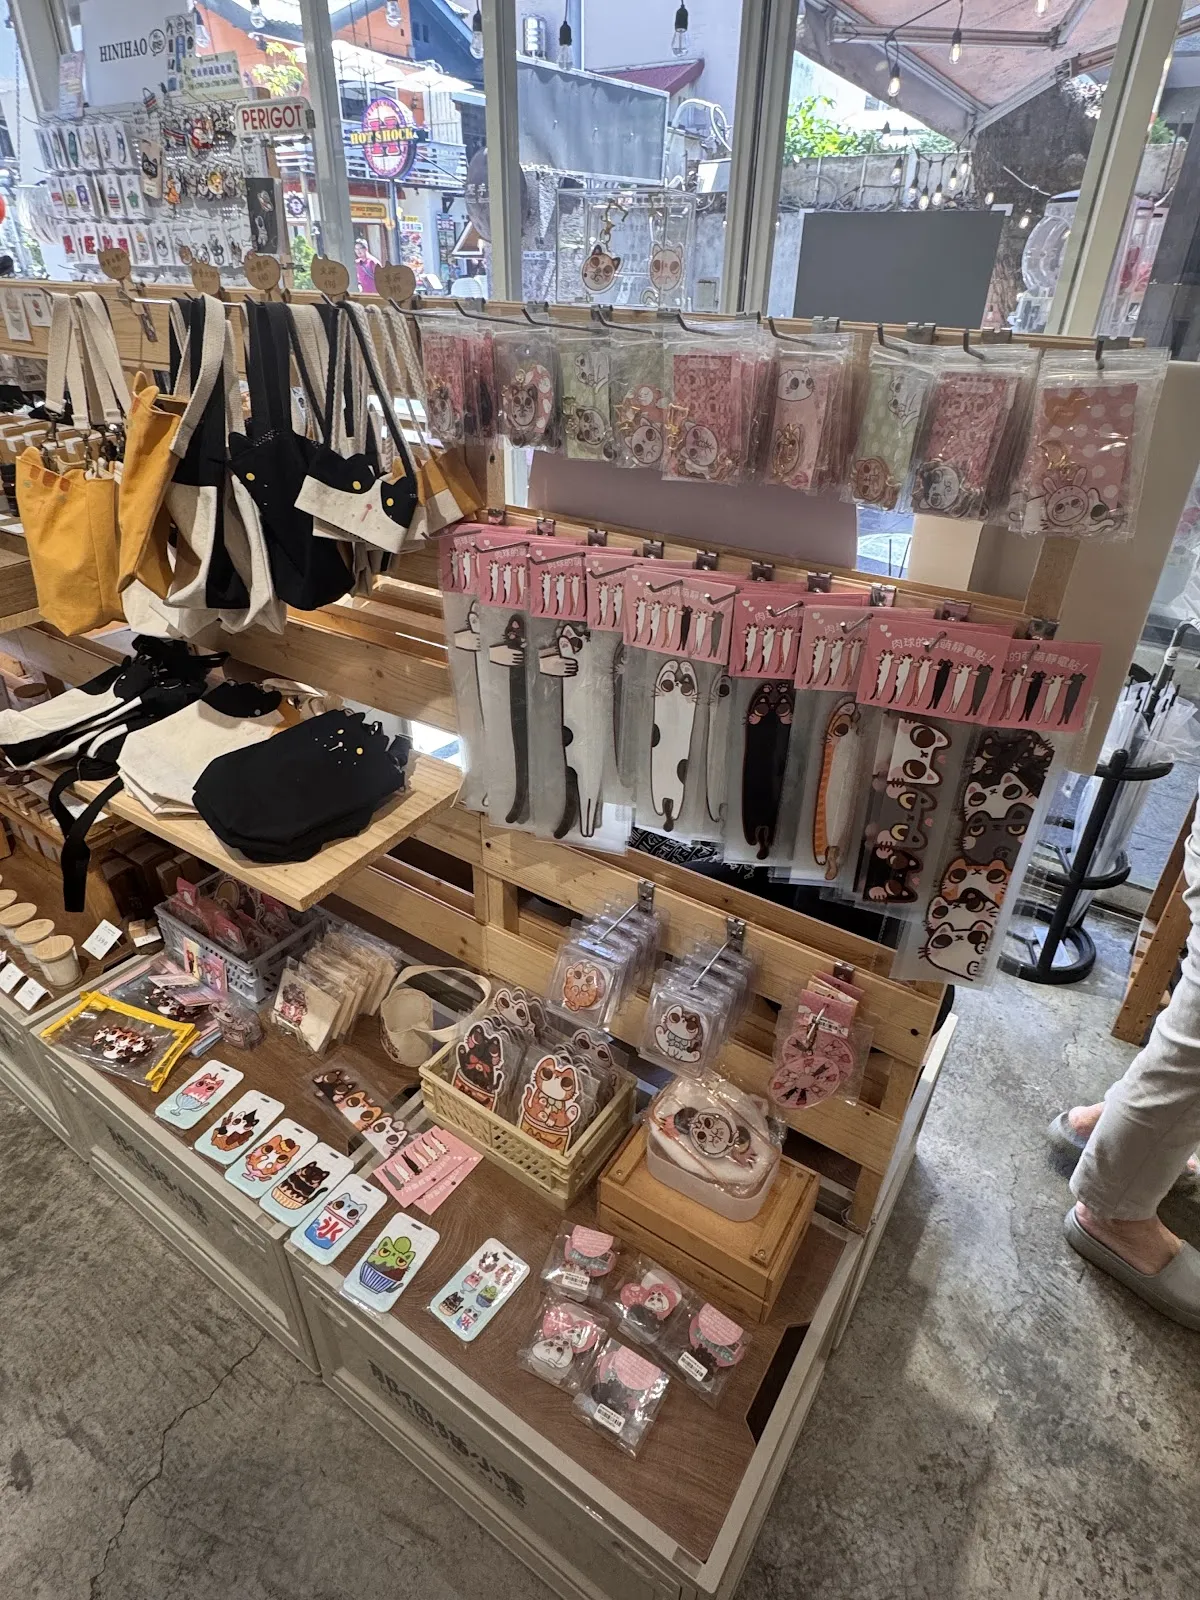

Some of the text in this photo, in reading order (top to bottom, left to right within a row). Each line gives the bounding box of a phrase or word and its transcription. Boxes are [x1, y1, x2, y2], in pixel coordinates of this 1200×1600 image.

[99, 37, 147, 62] HINIHAO
[241, 105, 302, 130] PERIGOT
[350, 128, 414, 145] HOT SHOCK
